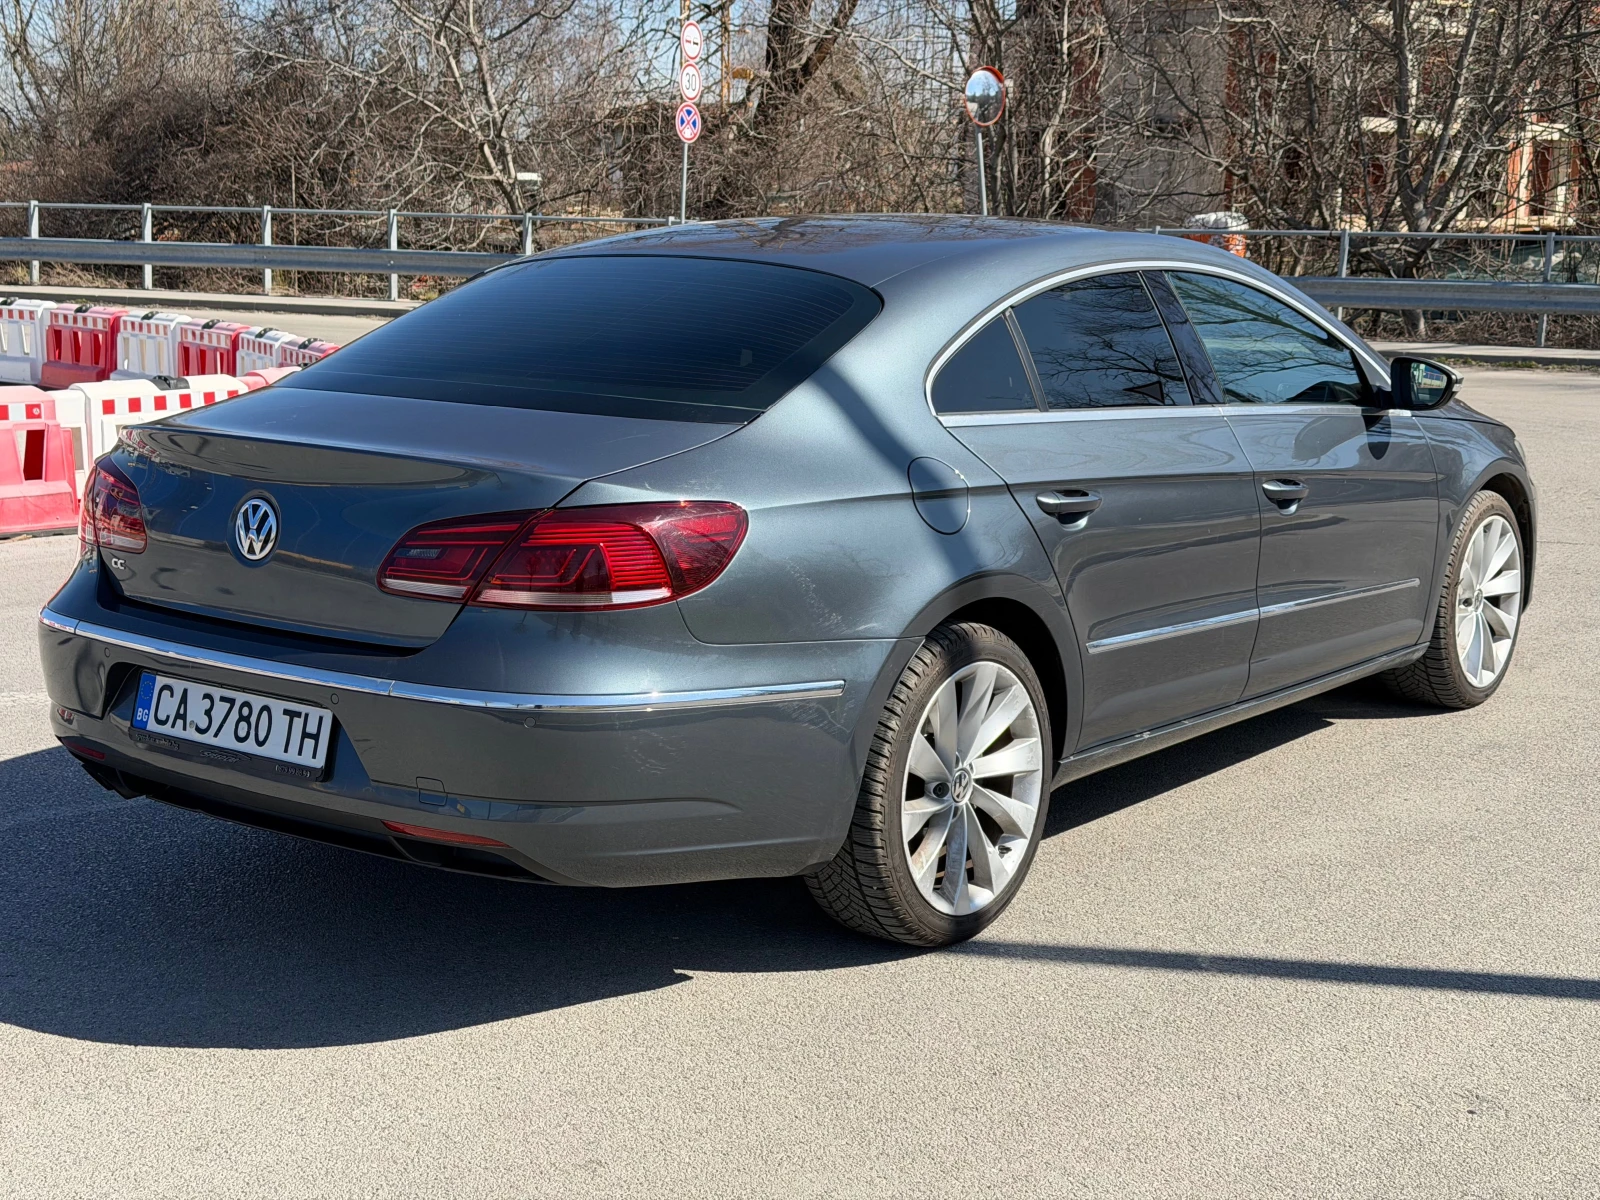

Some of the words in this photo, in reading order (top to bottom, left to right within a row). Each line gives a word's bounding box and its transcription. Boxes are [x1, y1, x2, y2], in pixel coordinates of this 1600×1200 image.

[685, 72, 697, 92] 30
[111, 558, 125, 570] CC
[136, 707, 149, 722] BG
[194, 693, 273, 748] 3780
[282, 708, 324, 760] TH
